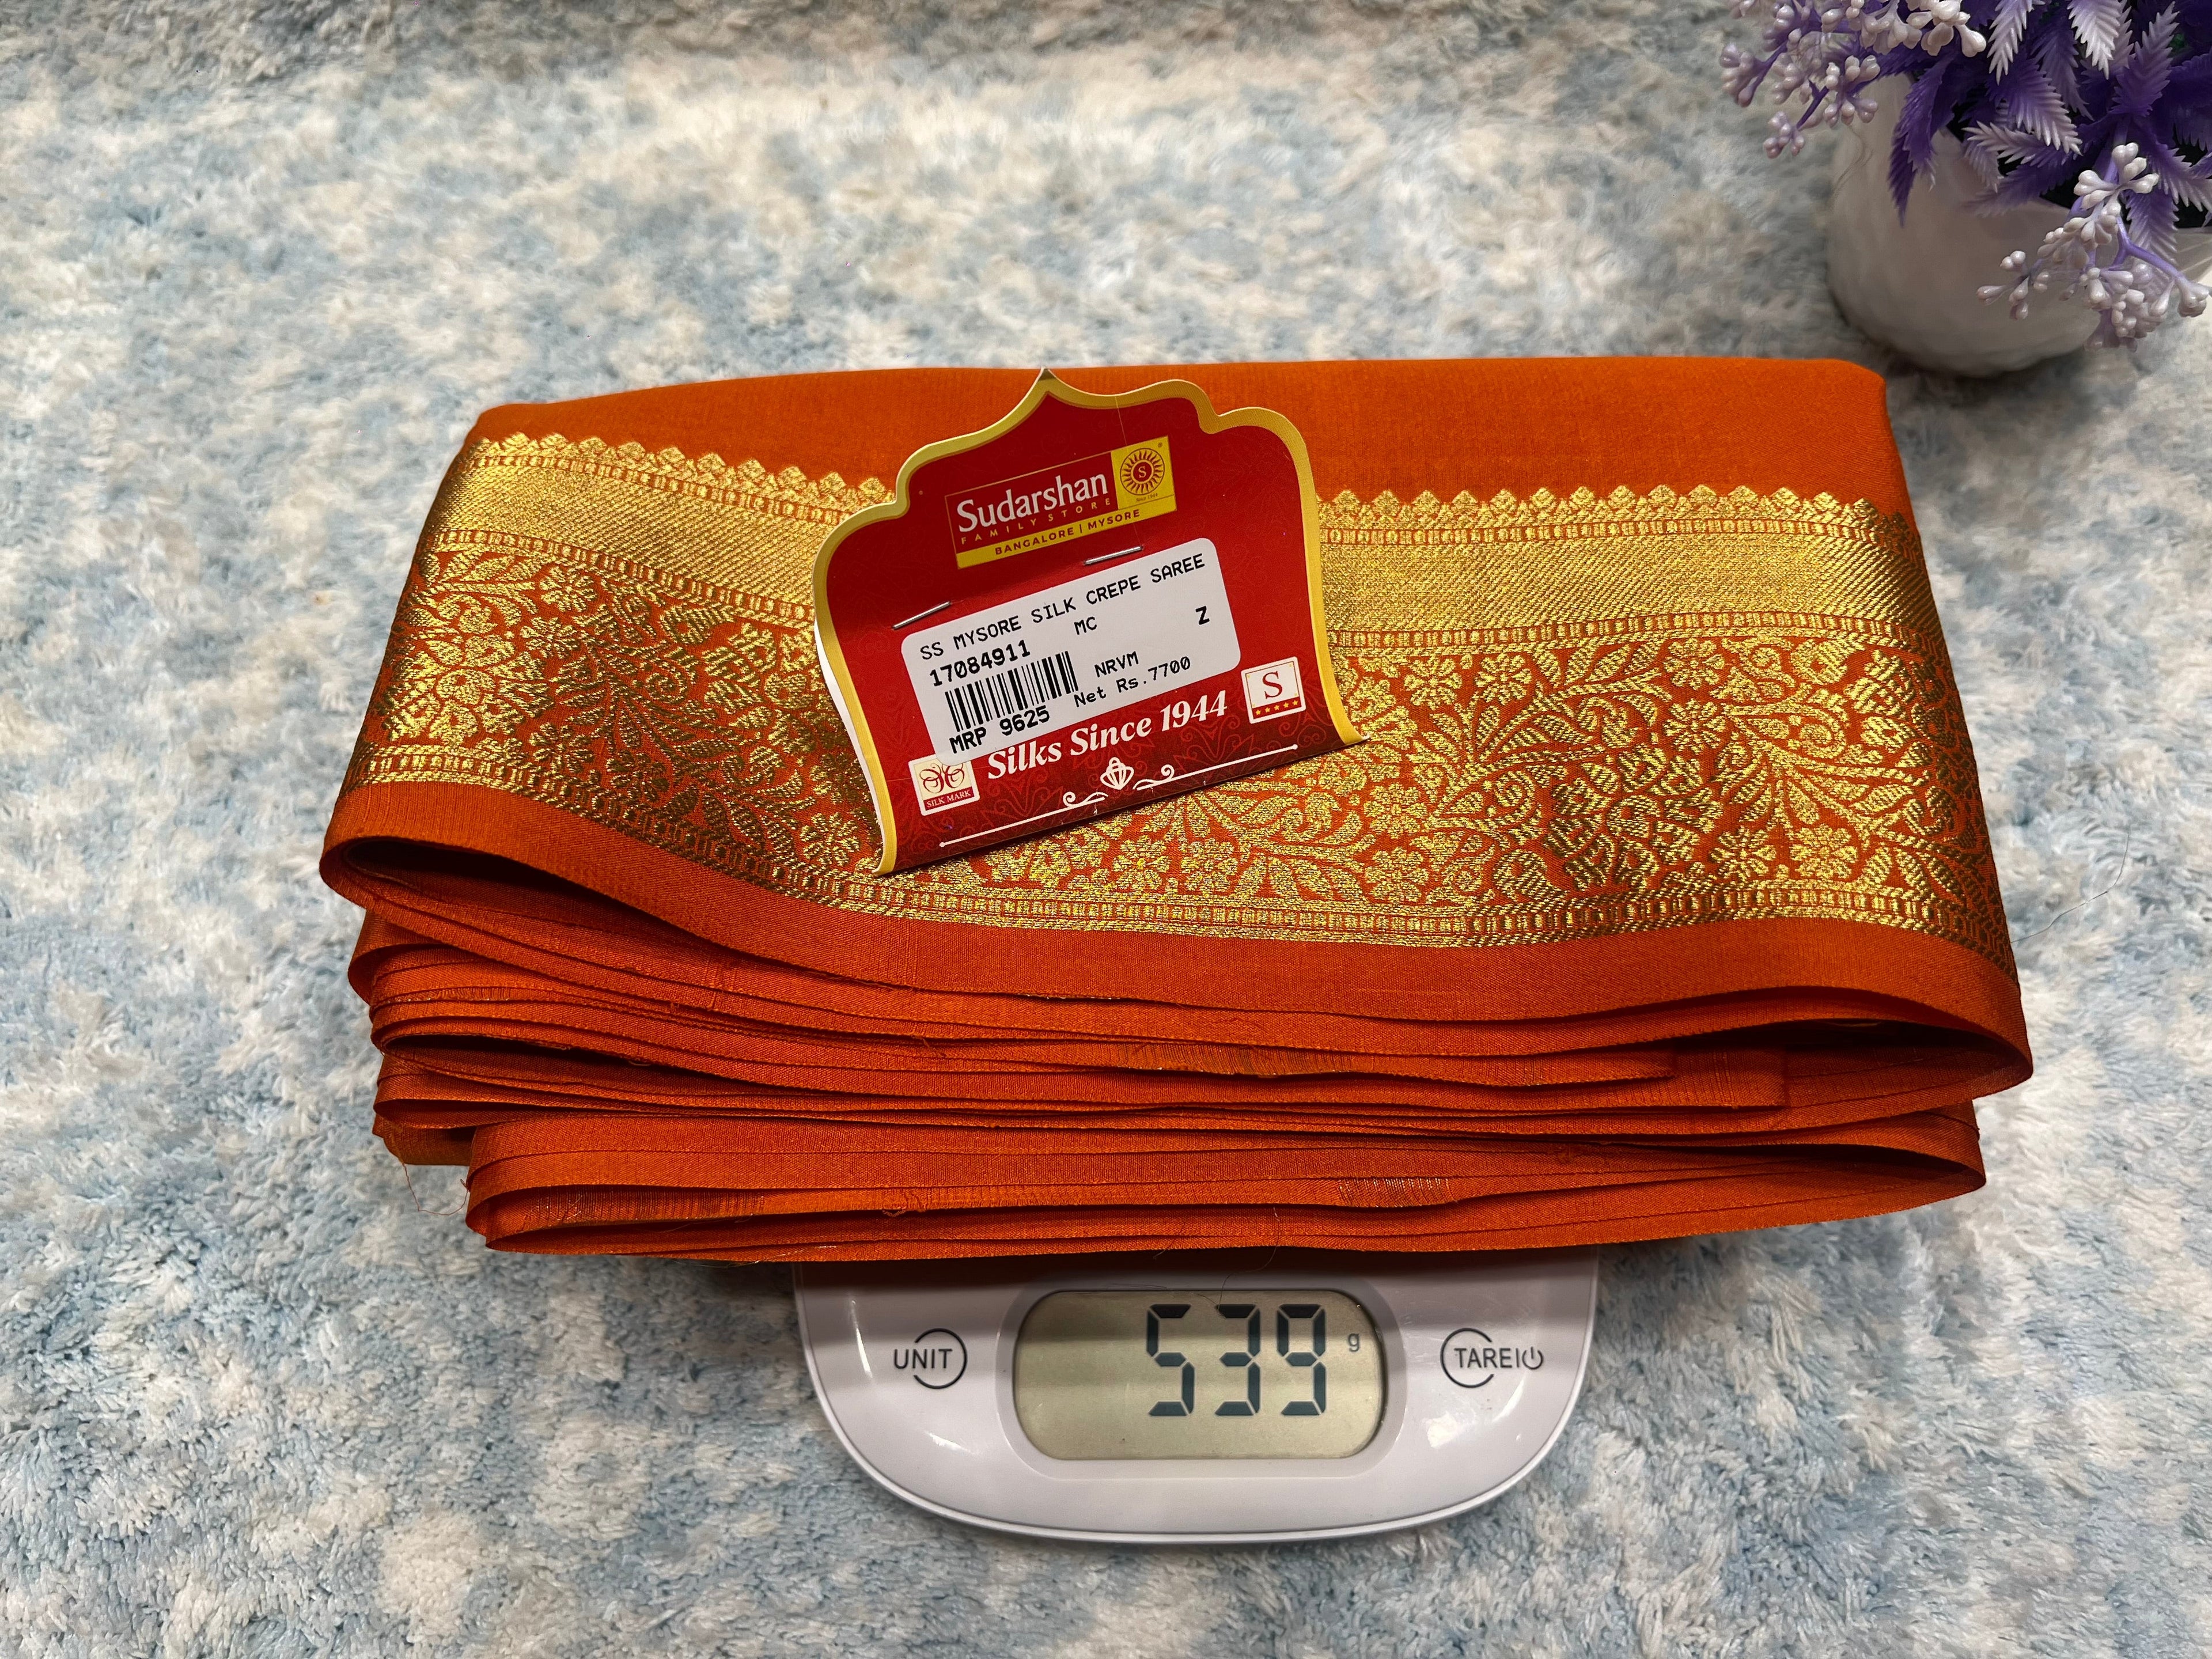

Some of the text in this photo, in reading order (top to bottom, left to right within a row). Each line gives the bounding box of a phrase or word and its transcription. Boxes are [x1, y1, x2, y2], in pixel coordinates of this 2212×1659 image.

[1138, 465, 1147, 478] S
[957, 474, 1108, 532] Sudarshan
[961, 498, 1111, 544] FAMILY STORE
[995, 509, 1141, 555] BANGALORE MYSORE
[920, 554, 1205, 660] SS MYSORE SILK CREPE SAREE
[929, 606, 1210, 687] 17084911 MC Z
[1094, 651, 1139, 678] NRVM
[1074, 656, 1191, 708] Net Rs.7700
[1262, 672, 1285, 700] S
[949, 705, 1051, 754] MRP 9625
[987, 690, 1228, 779] Silks Since 1944
[926, 789, 971, 808] SILK MARK
[893, 1347, 952, 1370] UNIT
[1146, 1303, 1361, 1417] 539 g
